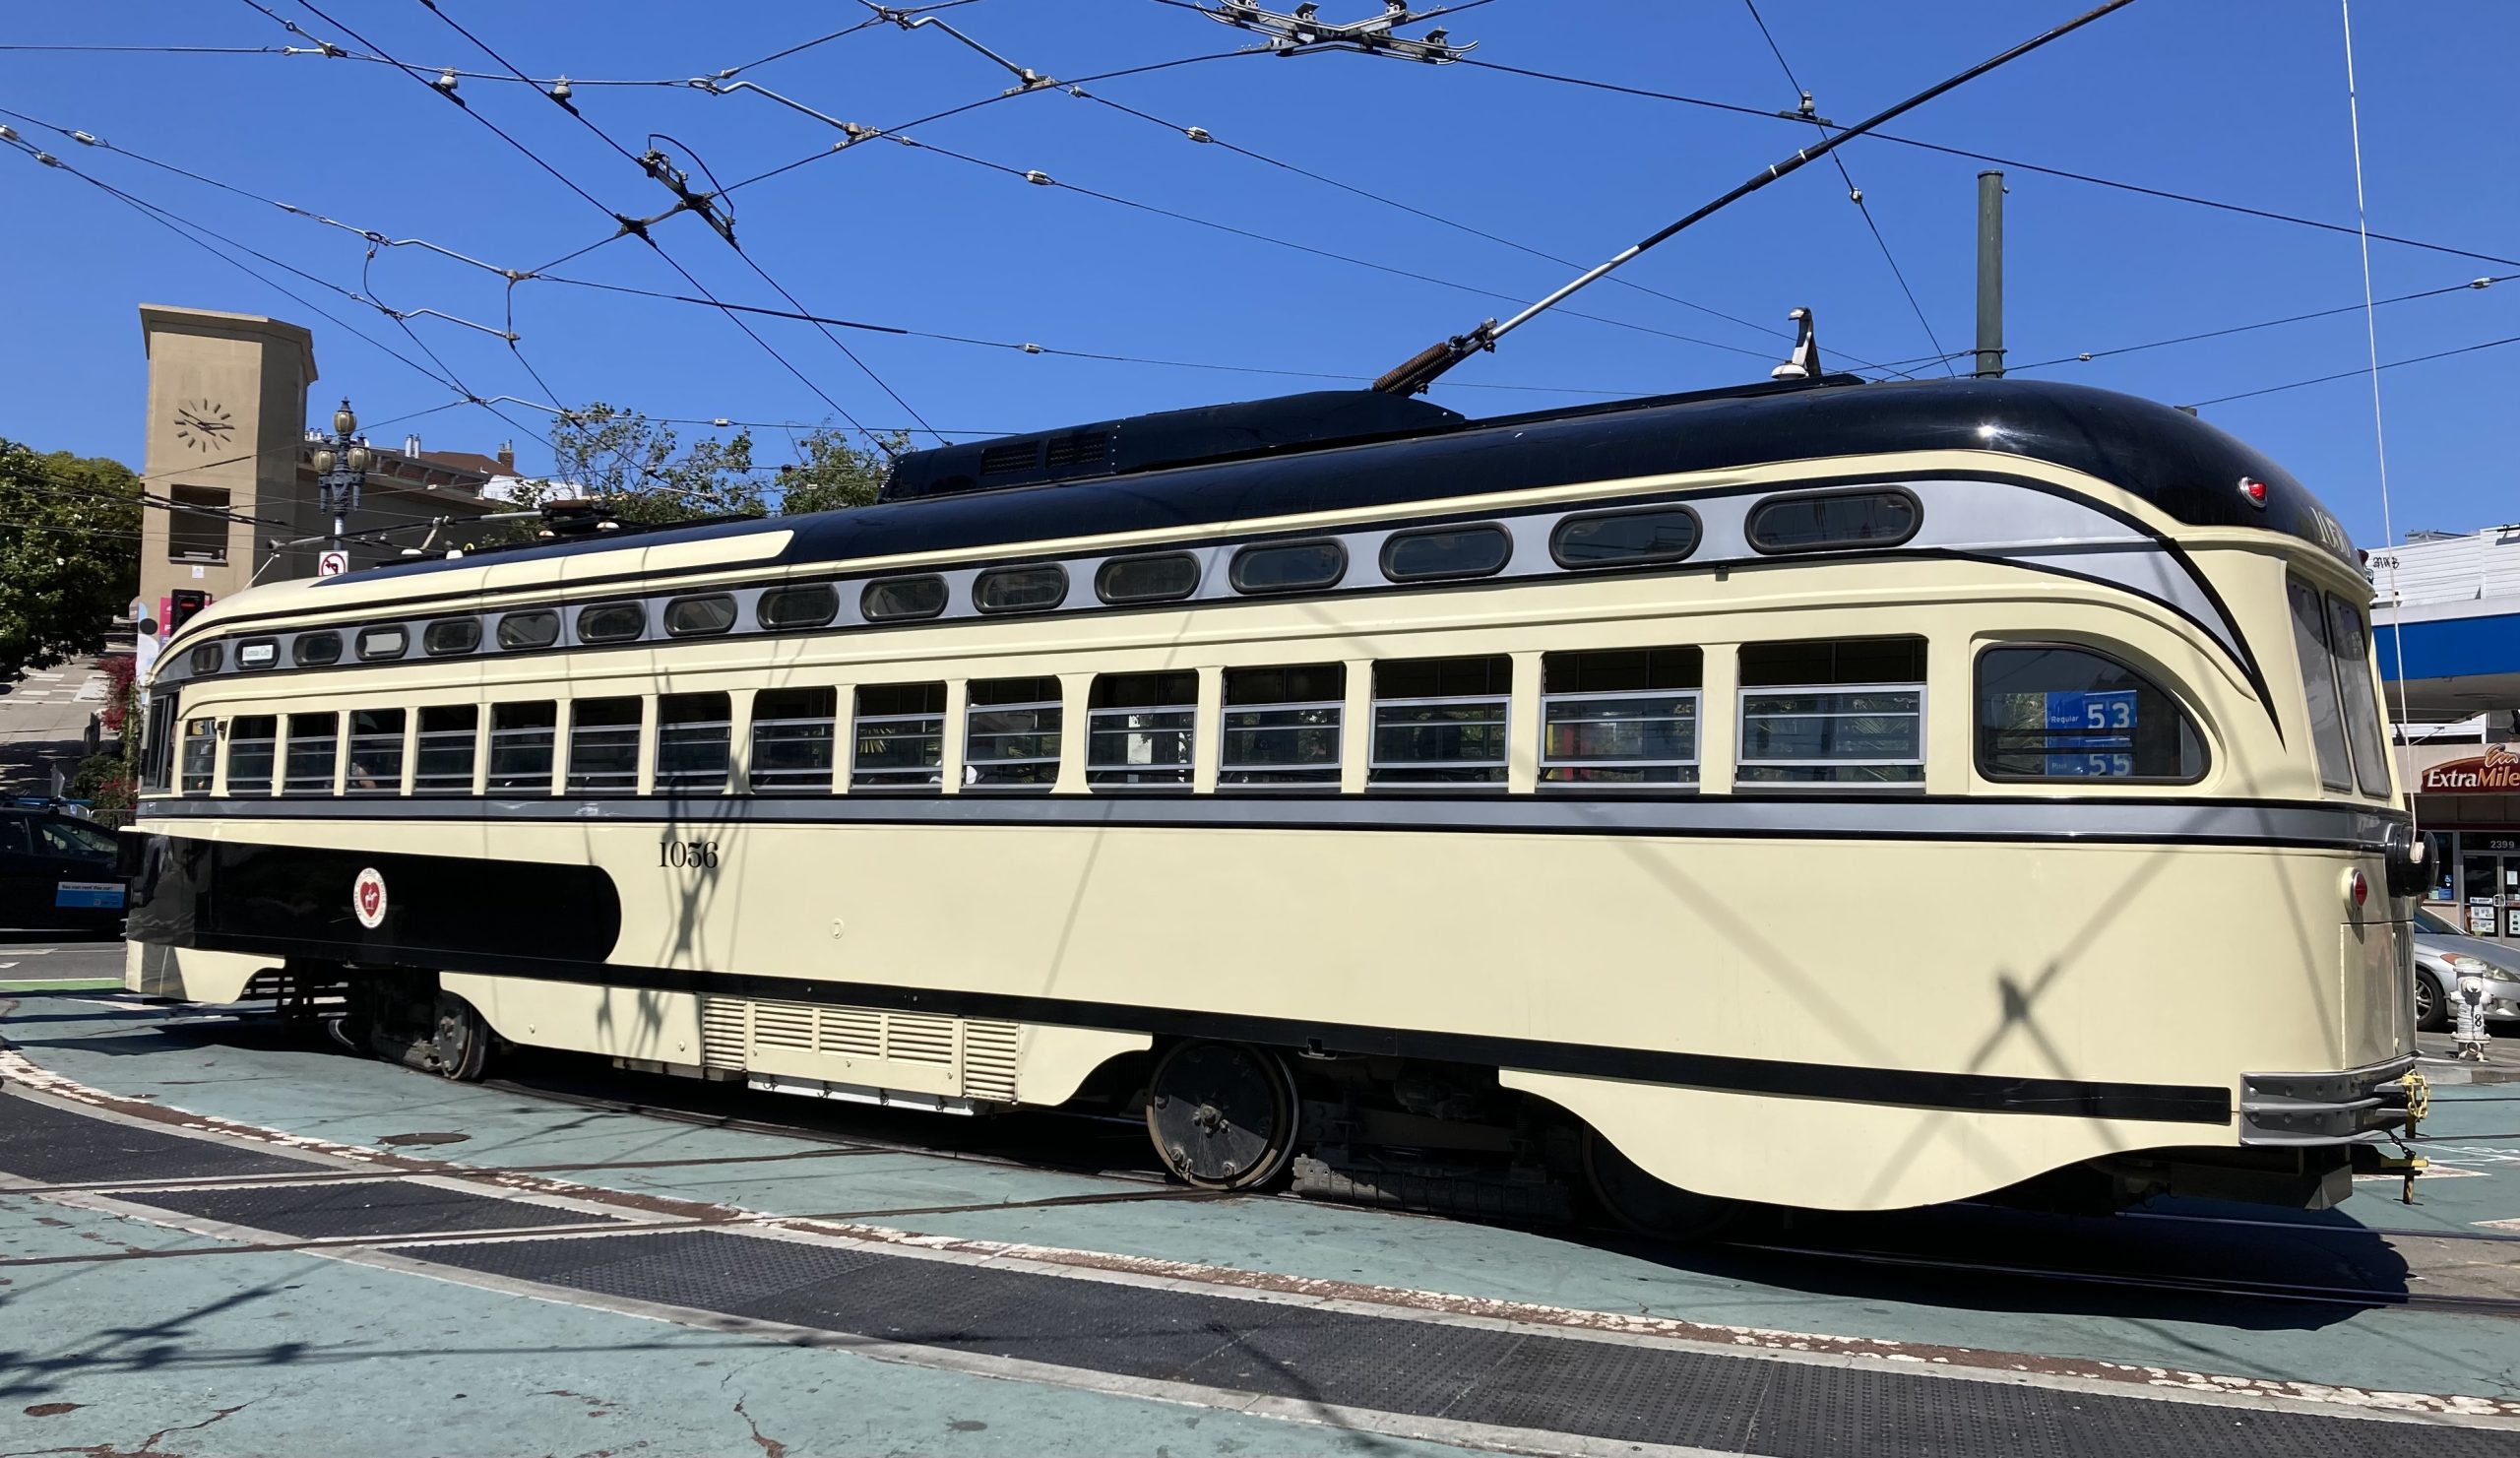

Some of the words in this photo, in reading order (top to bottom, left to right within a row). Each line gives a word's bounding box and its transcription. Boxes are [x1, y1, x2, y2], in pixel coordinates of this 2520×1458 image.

[2050, 716, 2080, 725] Regular
[2427, 766, 2520, 788] ExtraMile
[2490, 840, 2515, 849] 2399
[658, 841, 719, 868] 1056
[2474, 1014, 2482, 1028] 8
